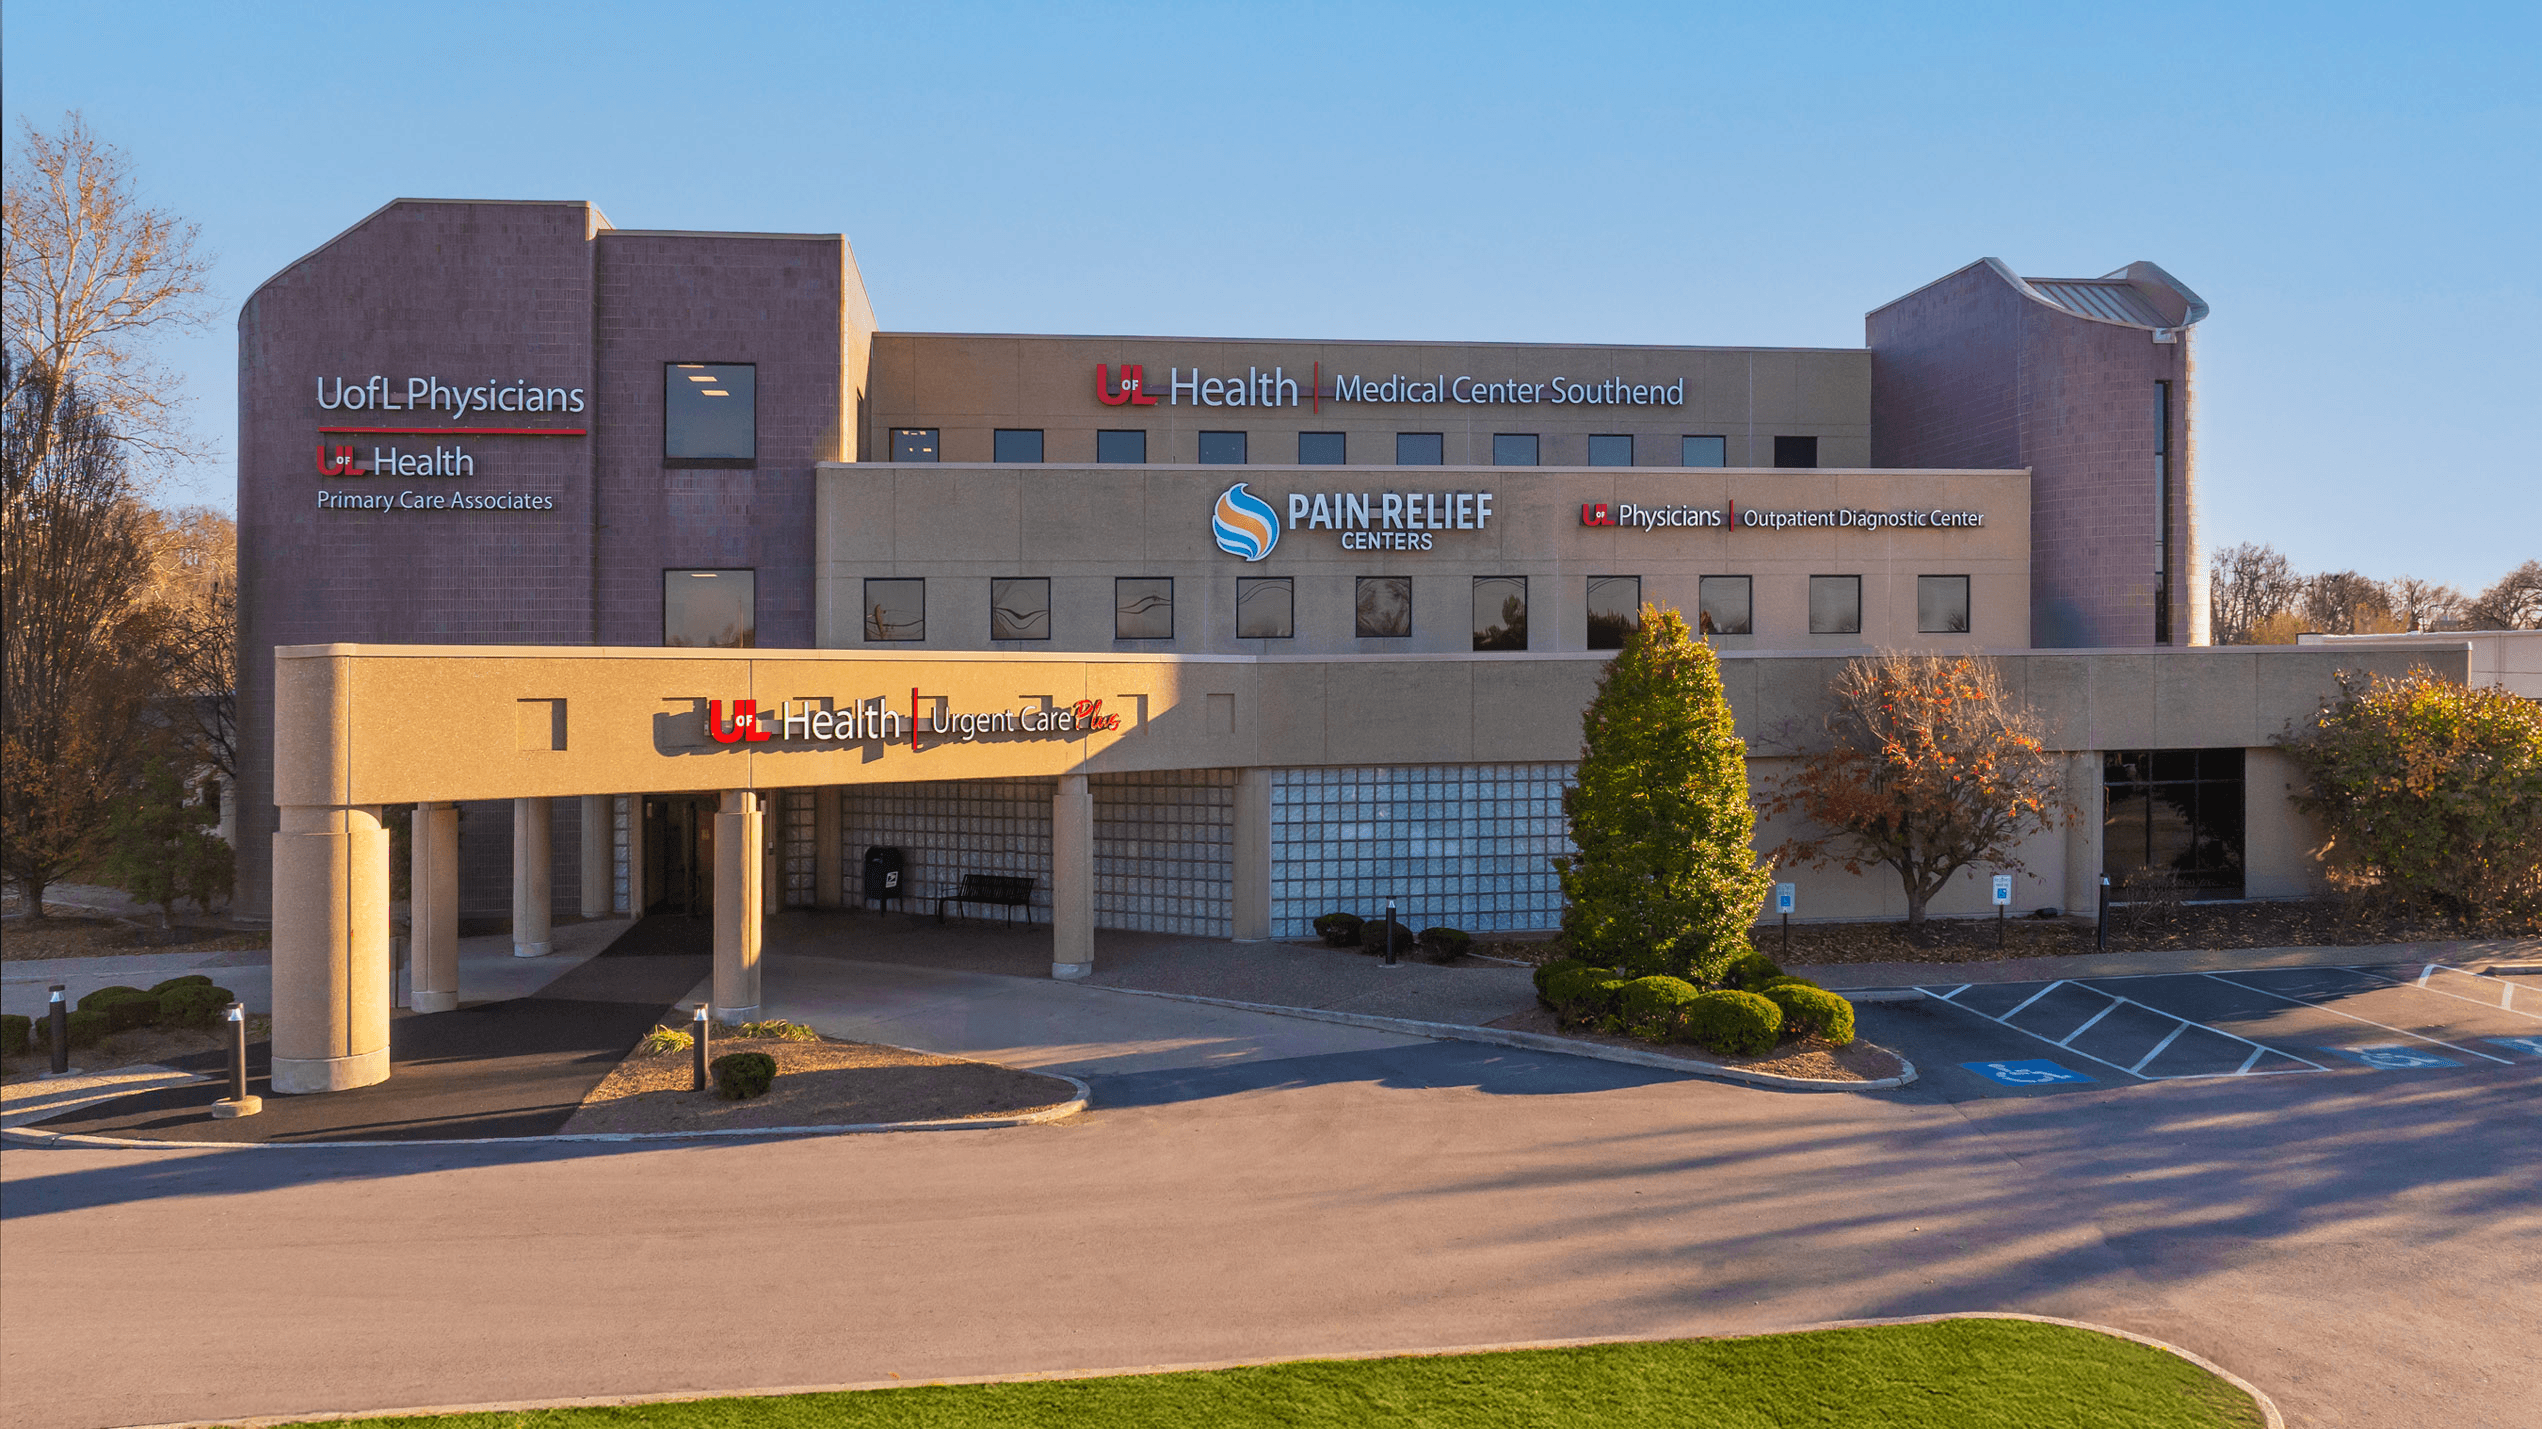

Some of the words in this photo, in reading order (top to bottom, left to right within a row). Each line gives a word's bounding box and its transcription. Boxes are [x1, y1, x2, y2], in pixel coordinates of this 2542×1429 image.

[318, 376, 401, 410] UofL
[408, 376, 585, 419] Physicians
[1171, 366, 1298, 407] Health
[1335, 374, 1443, 403] Medical
[1452, 376, 1544, 403] Center
[1551, 376, 1684, 405] Southend
[374, 446, 474, 476] Health
[318, 491, 394, 513] Primary
[400, 491, 444, 509] Care
[451, 491, 552, 509] Associates
[1289, 493, 1369, 530] PAIN
[1382, 493, 1493, 530] RELIEF
[1619, 504, 1721, 532] Physicians
[1744, 510, 1835, 531] Outpatient
[1839, 510, 1926, 531] Diagnostic
[1930, 510, 1984, 526] Center
[1341, 532, 1433, 550] CENTERS
[784, 698, 900, 740] Health
[932, 706, 1014, 740] Urgent
[1020, 705, 1070, 731] Care
[1074, 698, 1121, 731] Plus
